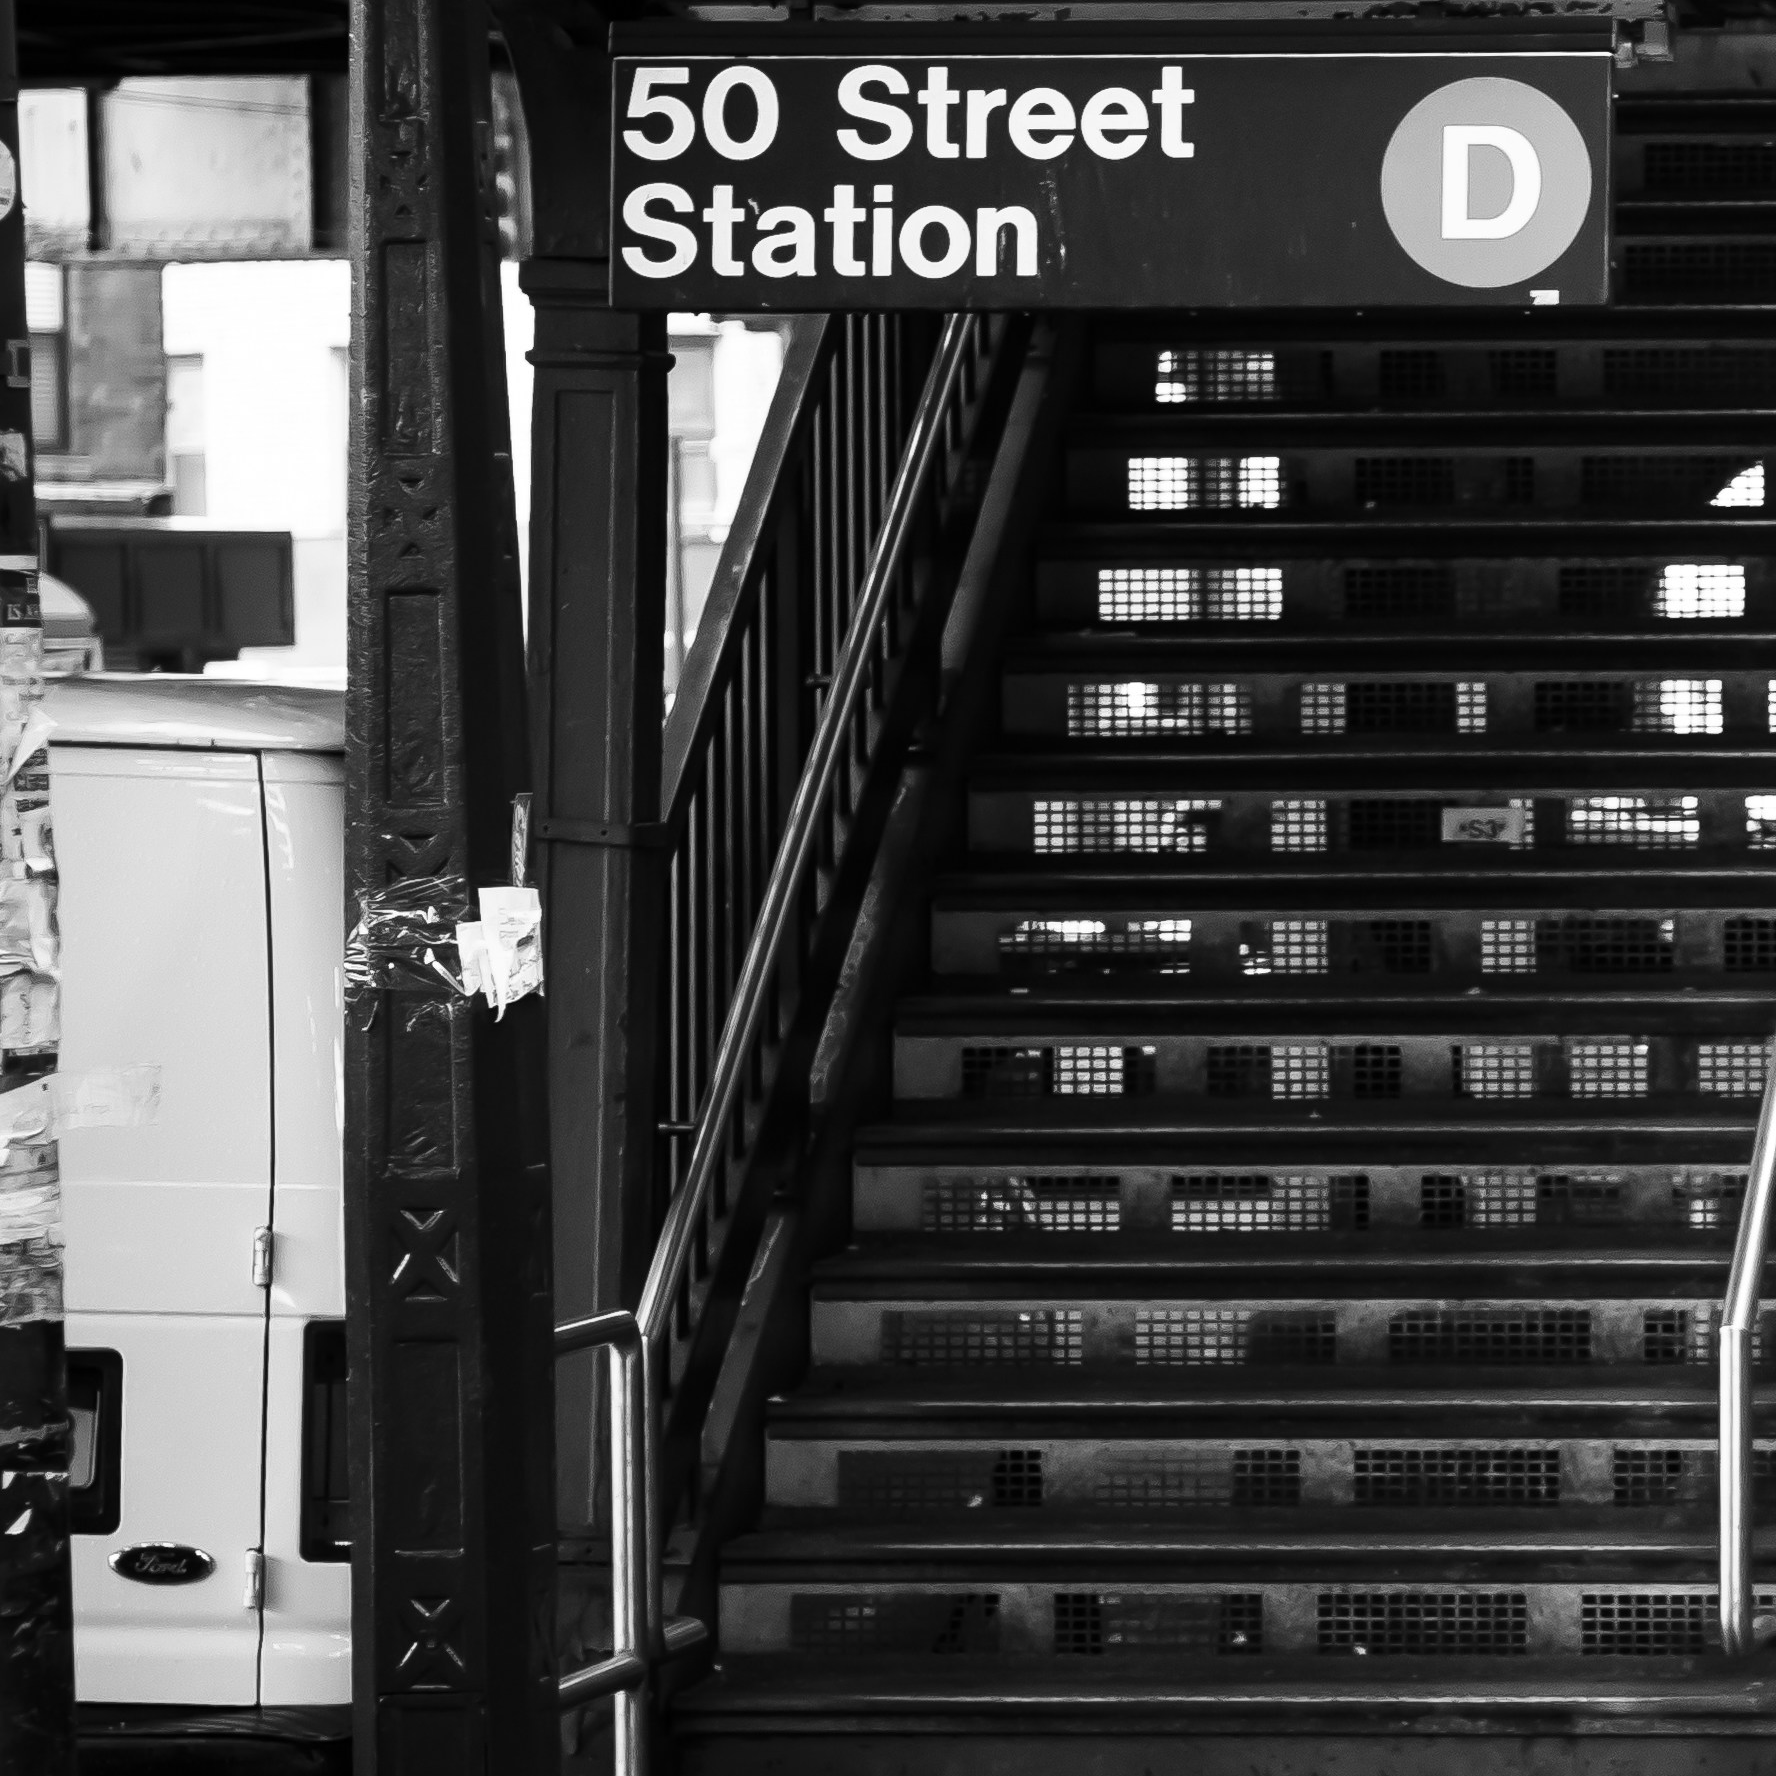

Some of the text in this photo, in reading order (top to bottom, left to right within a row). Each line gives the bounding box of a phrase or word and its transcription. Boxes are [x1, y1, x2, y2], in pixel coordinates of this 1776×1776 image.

[624, 65, 1194, 160] 50 Street
[1442, 126, 1541, 238] D
[623, 183, 1037, 278] Station
[134, 1552, 188, 1575] Ford
